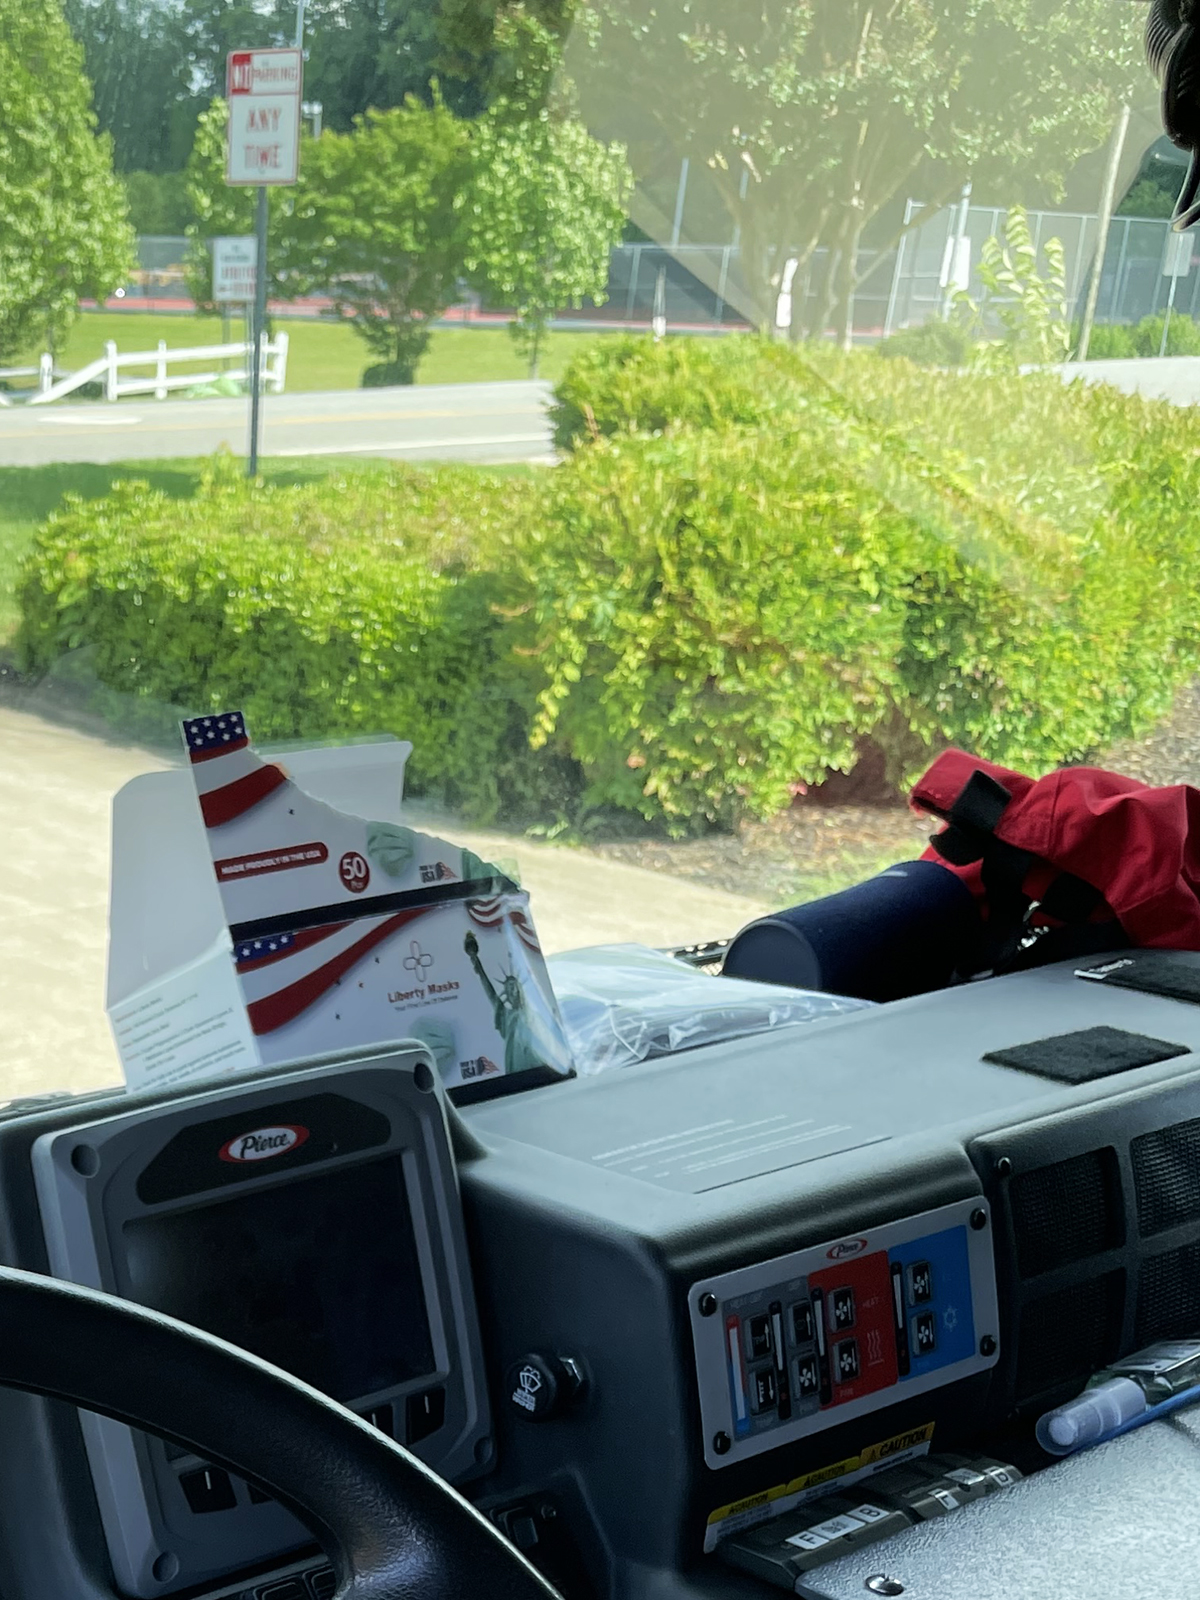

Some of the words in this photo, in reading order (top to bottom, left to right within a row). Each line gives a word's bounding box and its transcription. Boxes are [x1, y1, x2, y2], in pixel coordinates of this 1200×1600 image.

[246, 107, 282, 132] ANY
[244, 144, 282, 169] TIME
[342, 856, 367, 881] 50
[387, 988, 426, 1004] Liberty
[427, 980, 460, 995] Masks
[240, 1133, 291, 1159] Pierce
[880, 1428, 928, 1456] CAUTION
[798, 1533, 816, 1545] F
